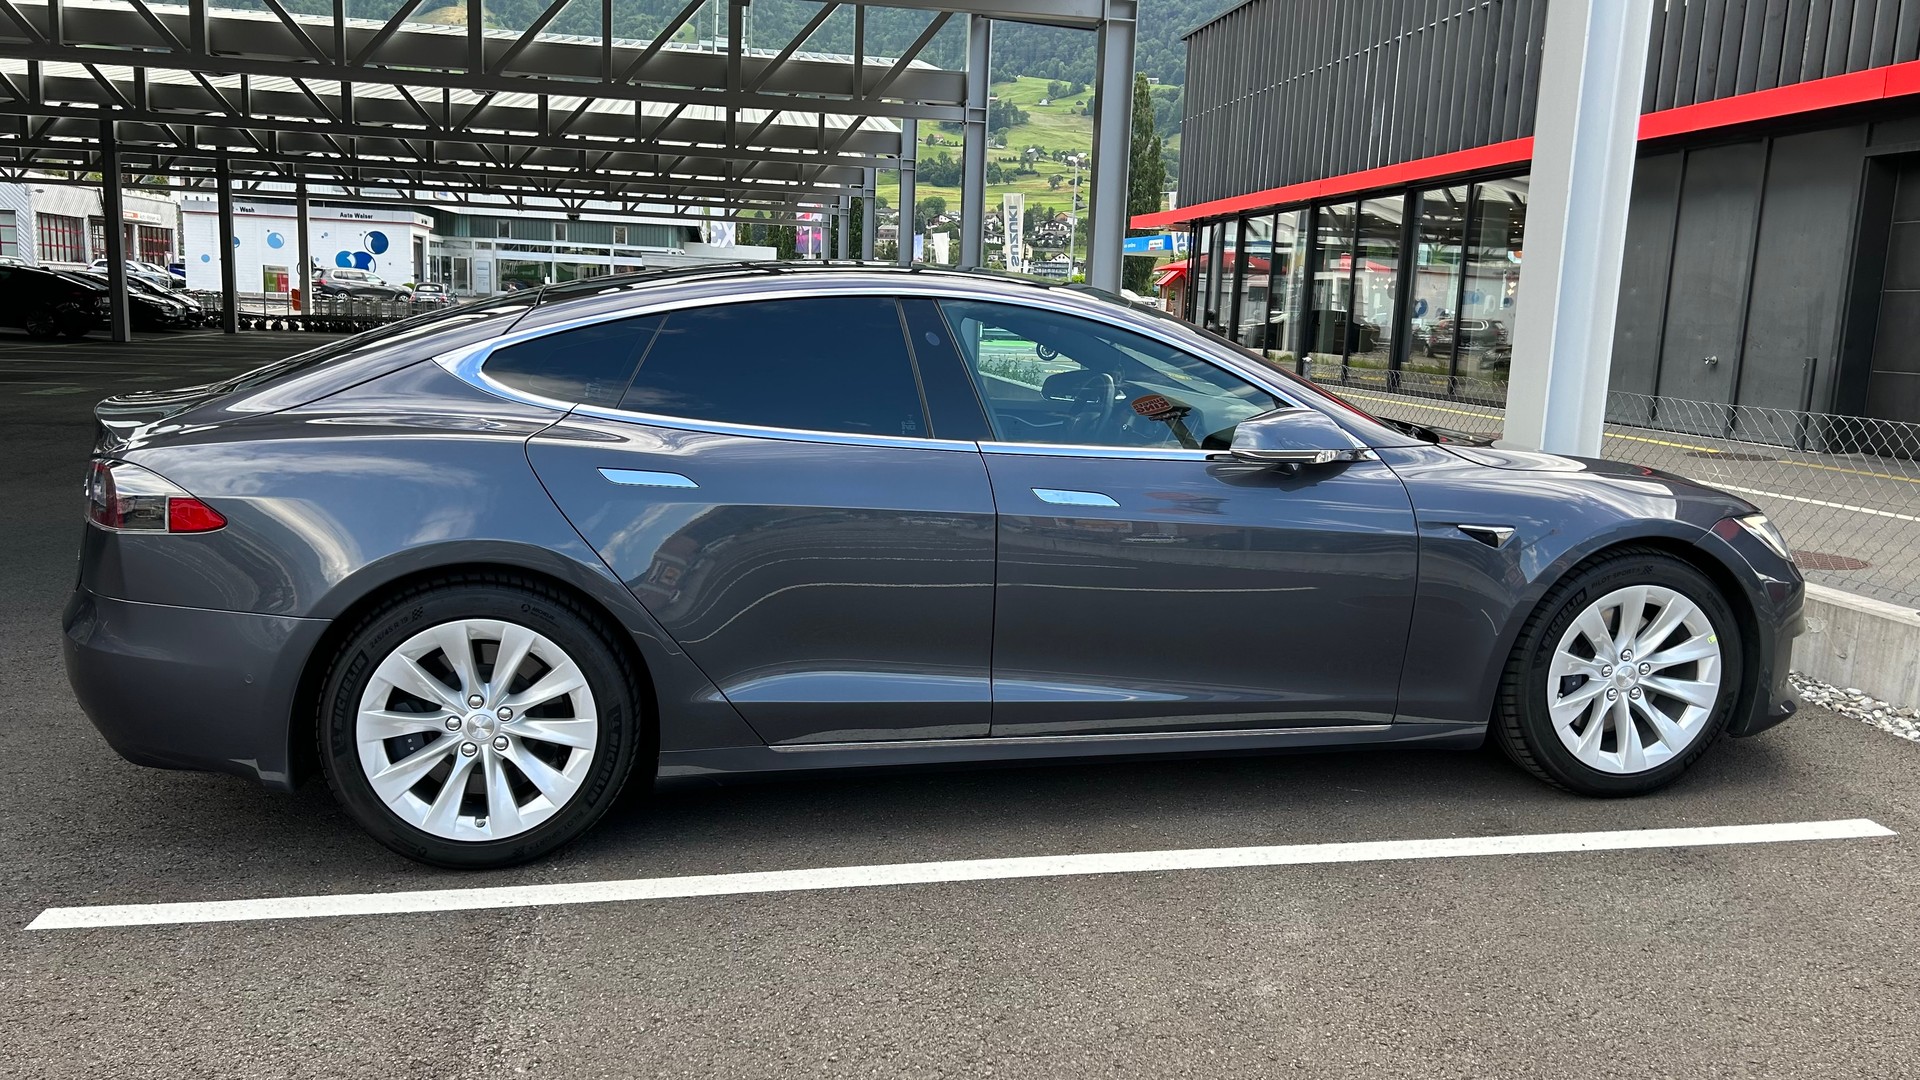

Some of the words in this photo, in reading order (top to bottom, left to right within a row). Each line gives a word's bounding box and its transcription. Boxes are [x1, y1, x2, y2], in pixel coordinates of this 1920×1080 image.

[1541, 589, 1586, 649] MICHELIN
[333, 655, 367, 731] MICHELIN
[587, 732, 619, 805] MICHELIN
